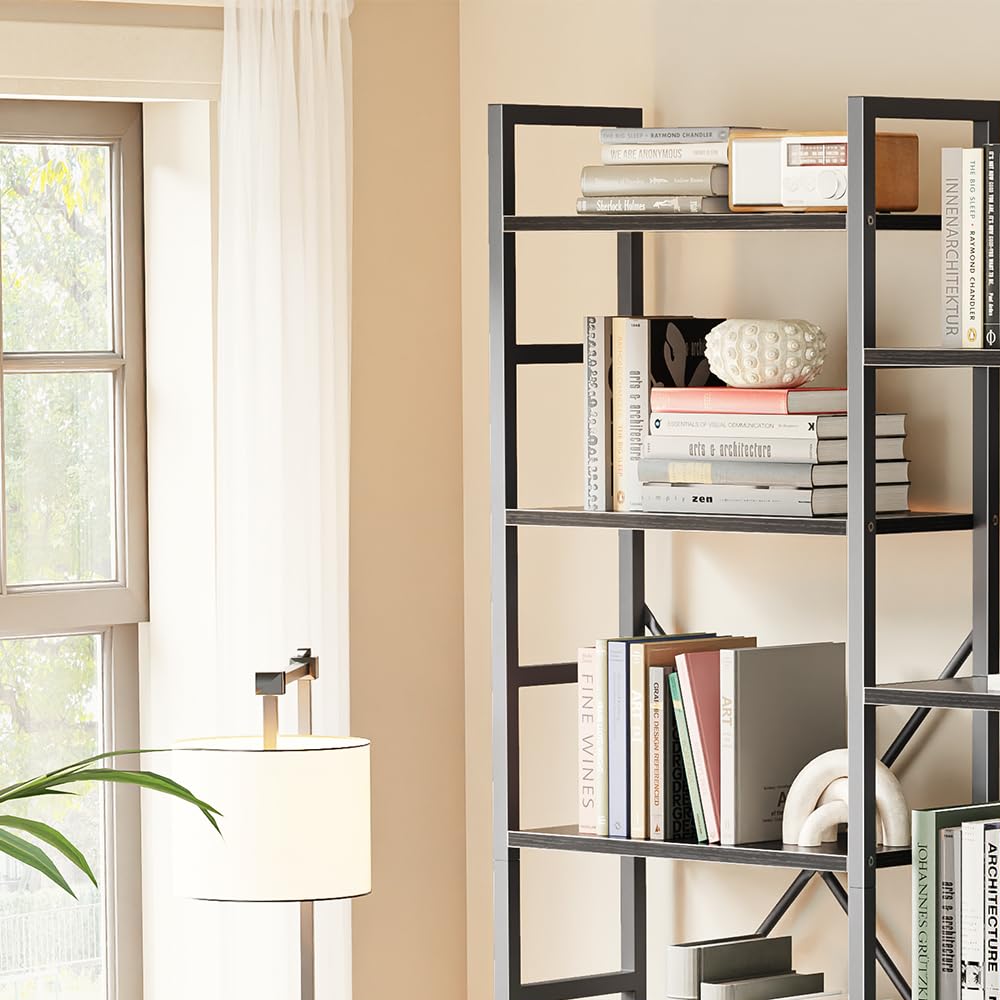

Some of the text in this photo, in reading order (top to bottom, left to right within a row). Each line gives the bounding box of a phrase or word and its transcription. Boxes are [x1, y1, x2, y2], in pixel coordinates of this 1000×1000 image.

[610, 149, 621, 160] WE
[623, 149, 637, 159] ARE
[638, 148, 682, 159] ANONYMOUS
[596, 200, 646, 212] Sherlock Holmes
[946, 178, 959, 336] INNENARCHITEKTUR
[630, 370, 641, 389] arts
[630, 404, 641, 462] architecture
[689, 442, 706, 456] arts
[720, 442, 772, 458] architecture
[692, 495, 713, 503] zen
[722, 696, 732, 726] ART
[582, 674, 594, 808] FINE WINES
[918, 842, 928, 928] JOHANNES
[942, 882, 954, 900] arts
[988, 842, 998, 972] ARCHITECTURE
[942, 916, 954, 973] architecture
